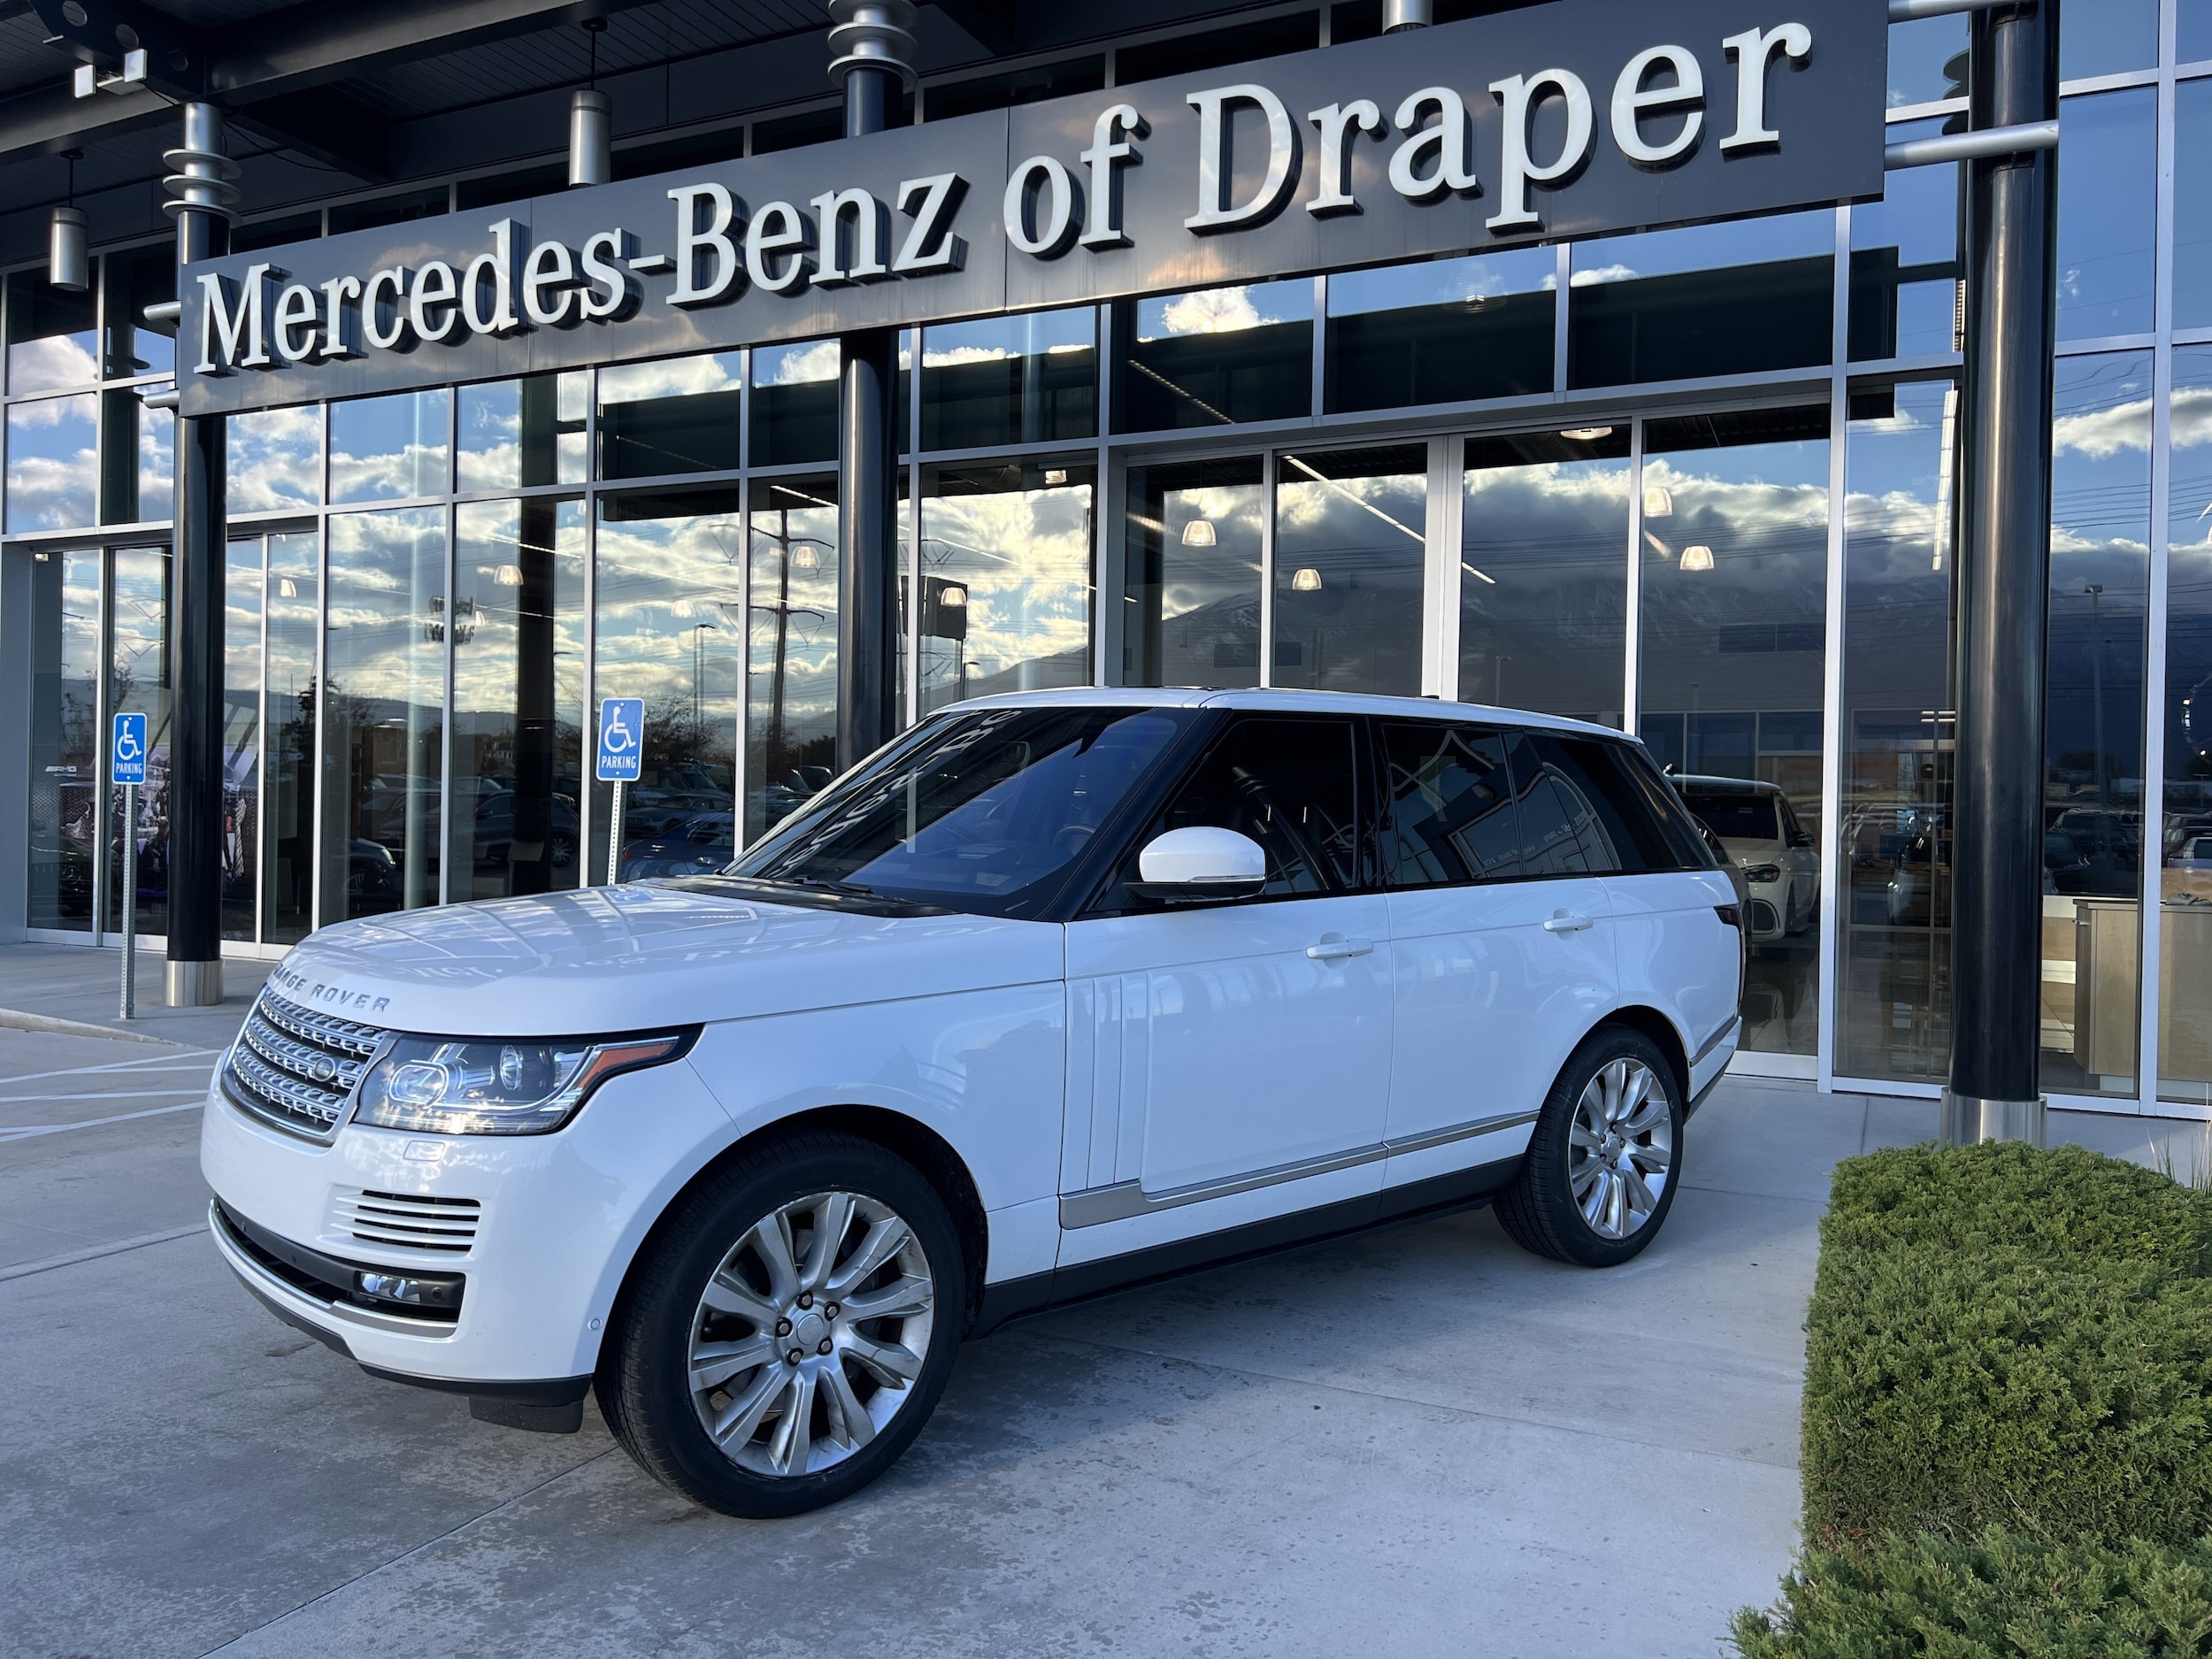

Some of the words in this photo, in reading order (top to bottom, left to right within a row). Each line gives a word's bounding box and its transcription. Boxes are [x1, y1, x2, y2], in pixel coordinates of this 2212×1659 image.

[194, 173, 960, 374] Mercedes-Benz
[1002, 104, 1141, 254] of
[1183, 22, 1813, 229] Draper
[115, 762, 143, 774] PARKING
[602, 755, 637, 769] PARKING
[311, 983, 390, 1012] ROVER
